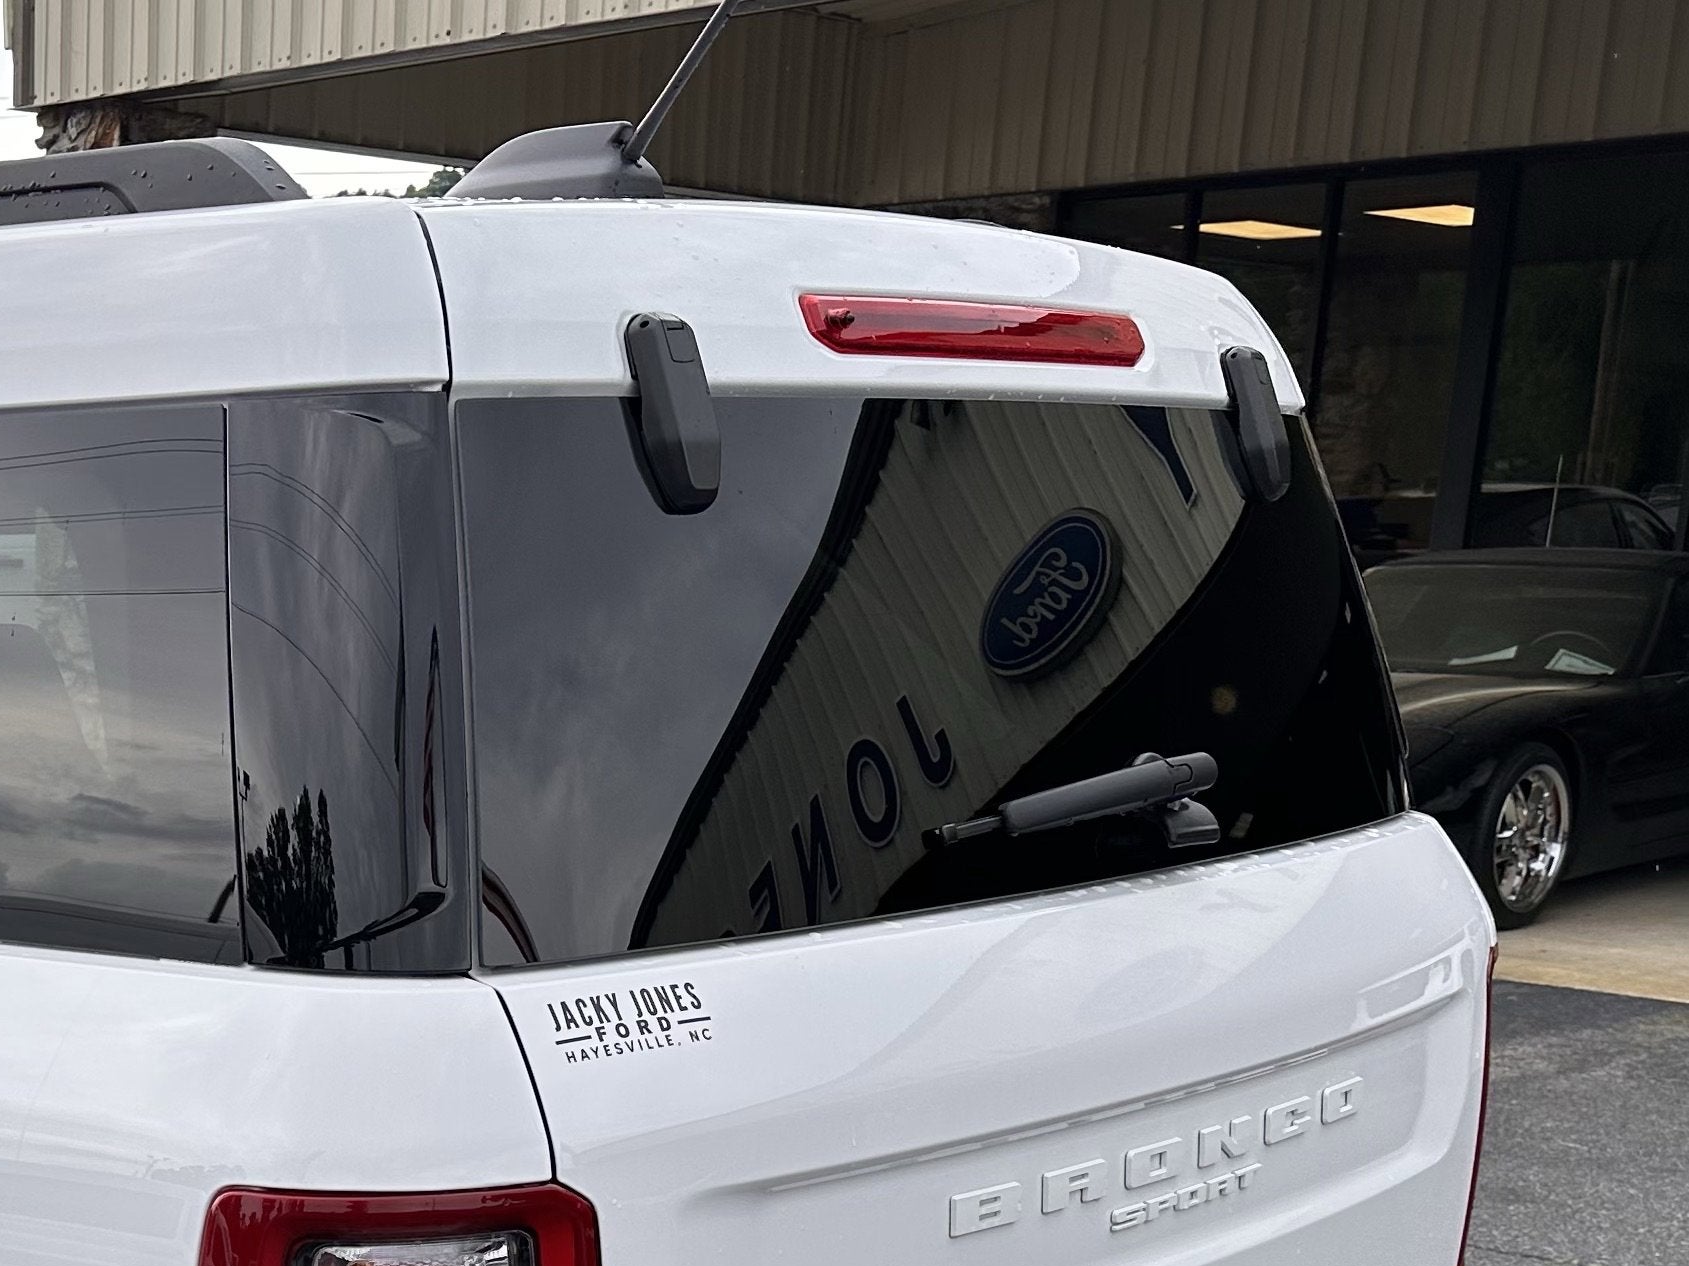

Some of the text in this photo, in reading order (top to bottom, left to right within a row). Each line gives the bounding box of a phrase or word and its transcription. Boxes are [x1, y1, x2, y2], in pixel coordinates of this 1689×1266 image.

[547, 982, 702, 1032] JACKY JONES
[595, 1016, 672, 1042] FORD
[689, 1028, 712, 1043] NC
[949, 1076, 1363, 1238] BRONCO
[1110, 1162, 1263, 1233] SPORT
